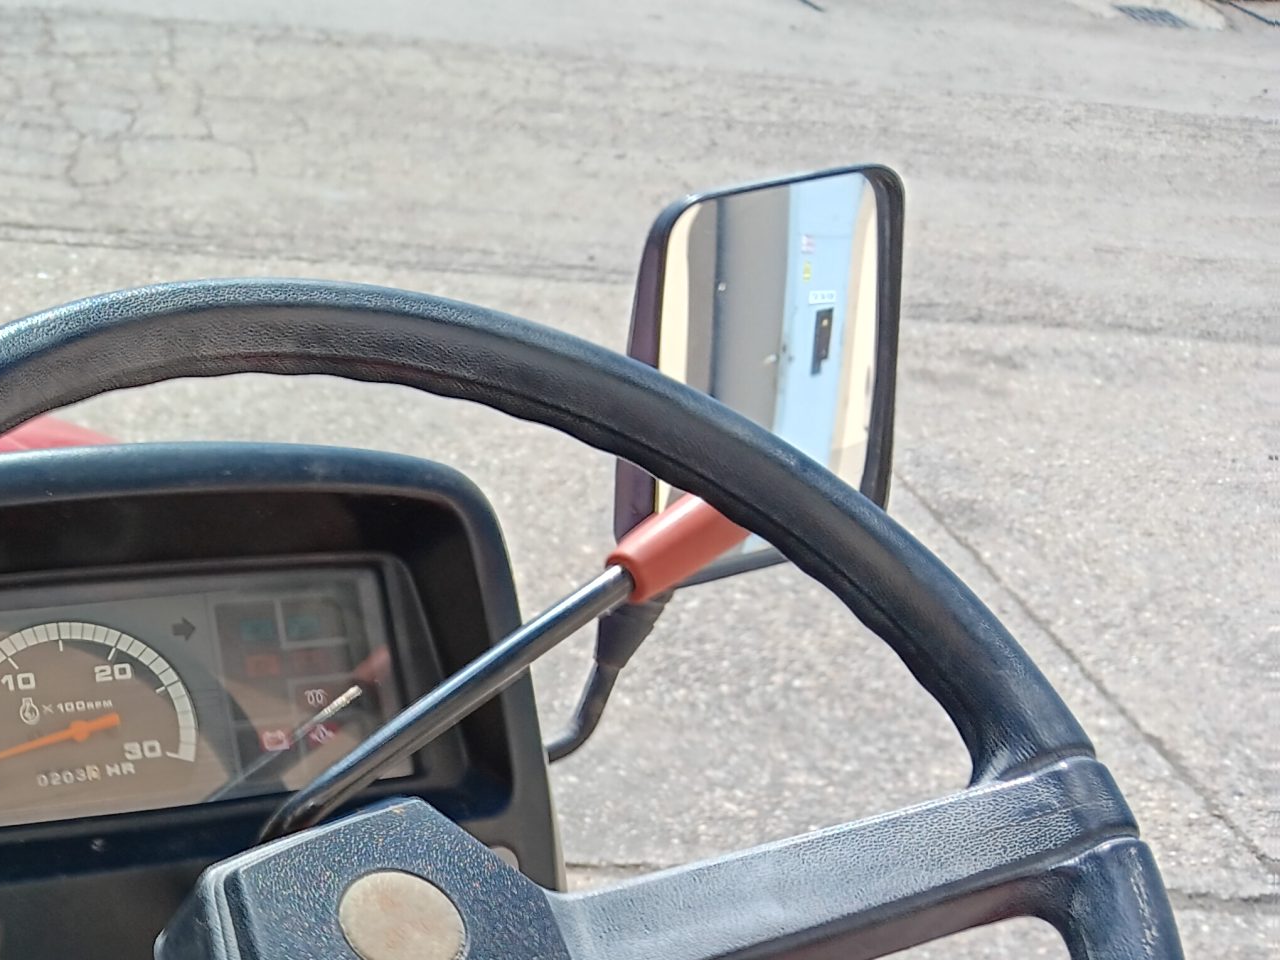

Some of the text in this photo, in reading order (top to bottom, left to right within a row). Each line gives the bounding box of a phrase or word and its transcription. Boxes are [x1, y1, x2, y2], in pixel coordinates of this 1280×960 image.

[1, 672, 36, 691] 10
[94, 662, 132, 682] 20
[123, 740, 162, 760] 30
[105, 762, 136, 777] HR
